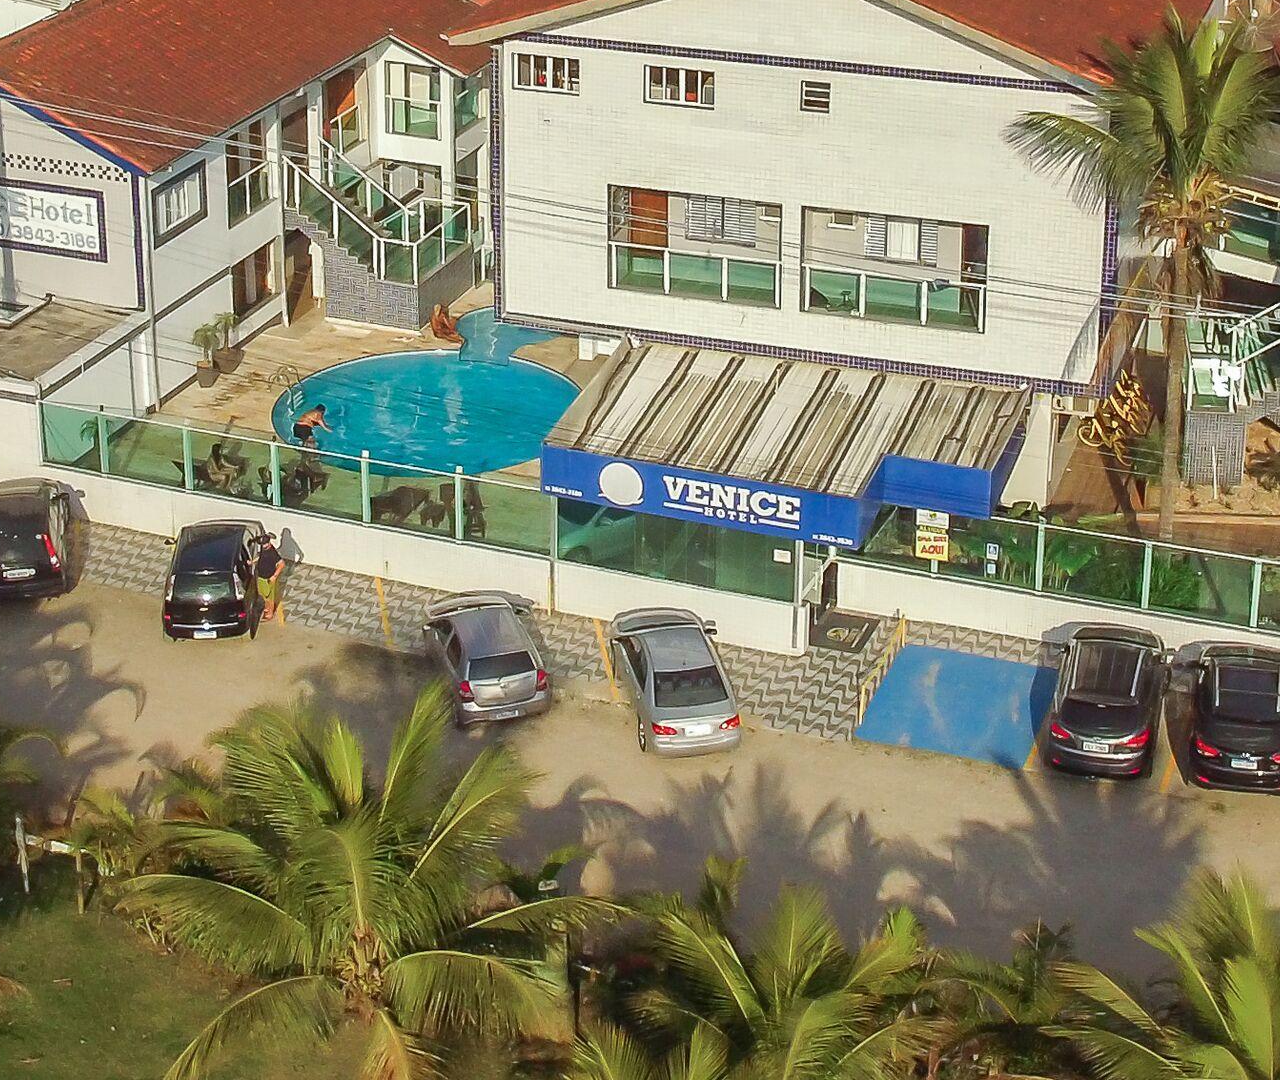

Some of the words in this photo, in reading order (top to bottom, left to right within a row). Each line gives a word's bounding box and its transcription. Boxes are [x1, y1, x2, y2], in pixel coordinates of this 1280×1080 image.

[29, 196, 95, 226] Hotel
[11, 224, 97, 249] 3843-3186
[662, 475, 800, 522] VENICE
[704, 507, 758, 524] HOTEL
[921, 544, 944, 555] AQUI
